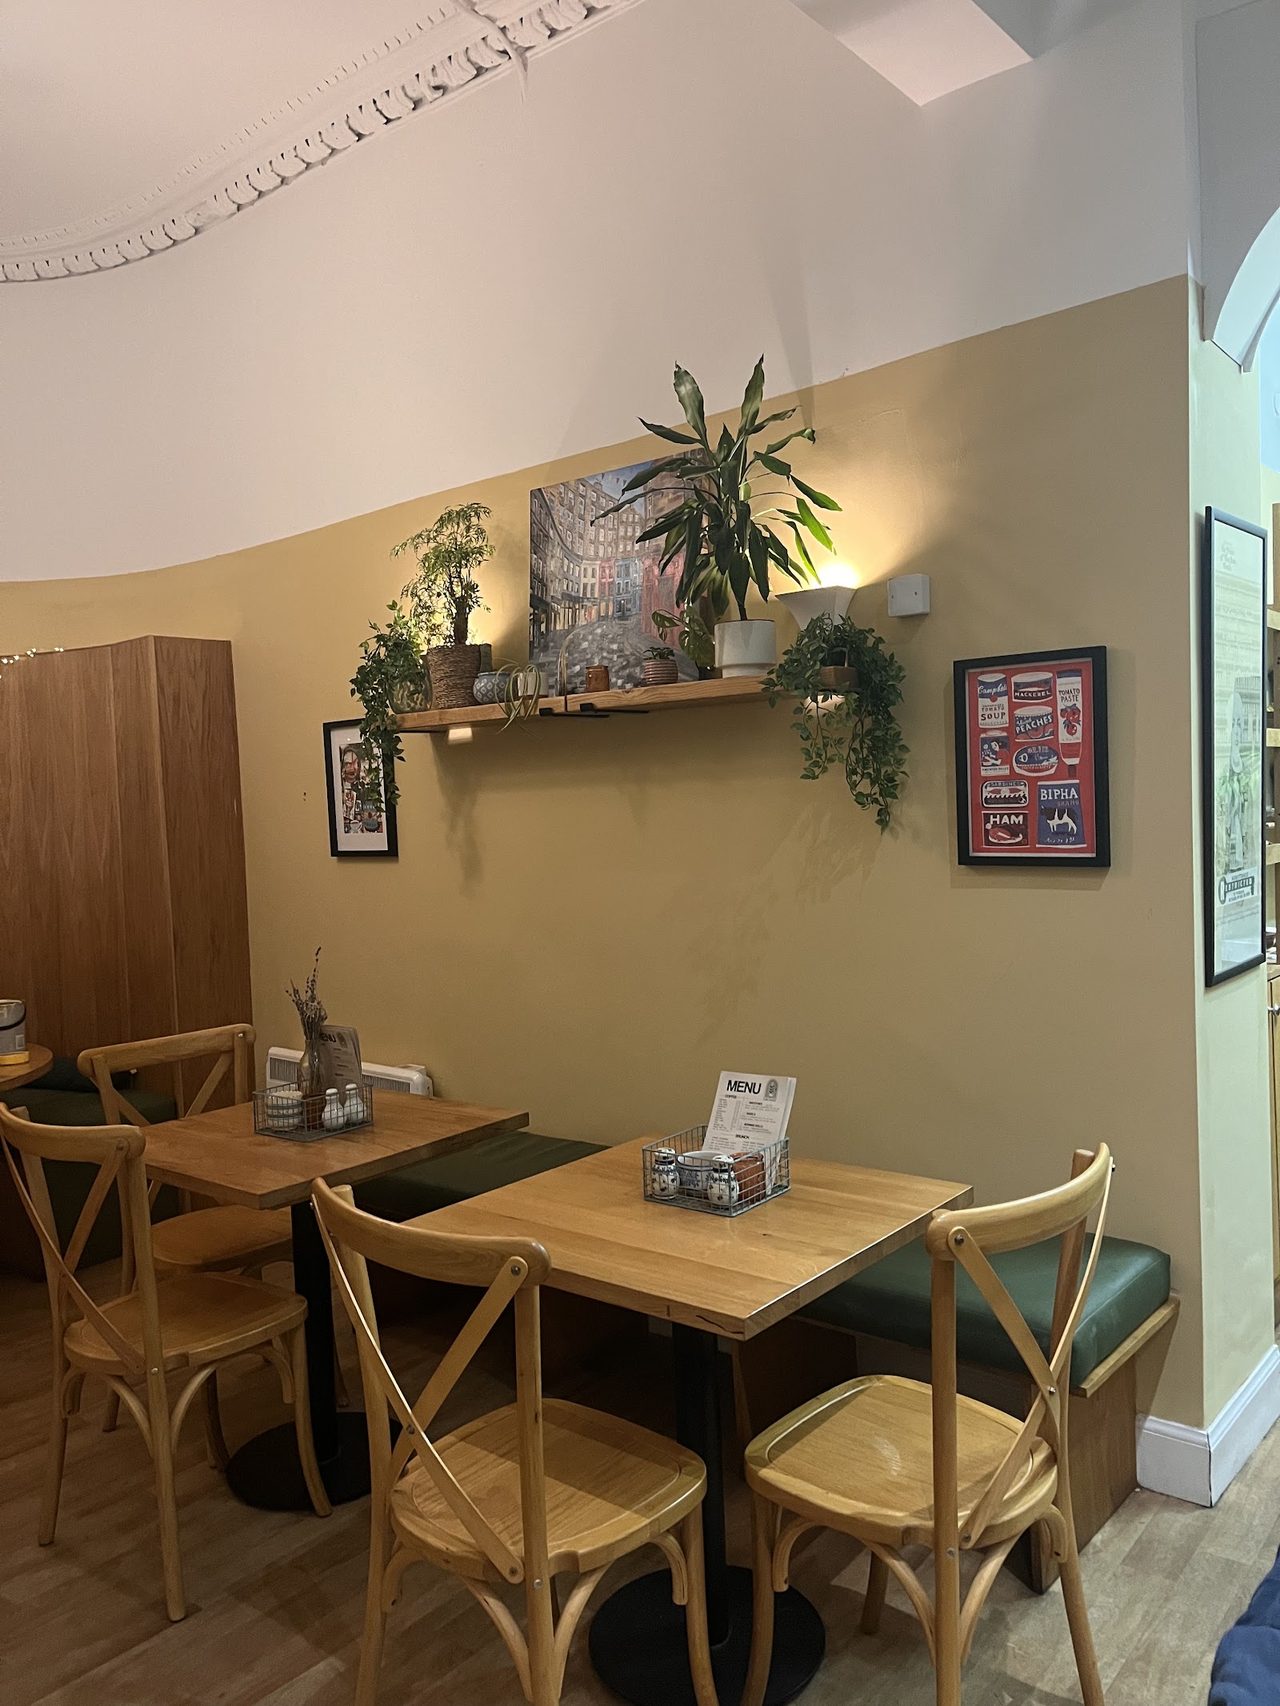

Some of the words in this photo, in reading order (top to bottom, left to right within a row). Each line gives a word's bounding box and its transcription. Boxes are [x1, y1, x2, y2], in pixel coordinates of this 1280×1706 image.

[981, 712, 1005, 721] SOUP
[1016, 715, 1052, 734] PEACHES
[1040, 787, 1079, 800] BIPHA
[990, 814, 1024, 825] HAM
[727, 1080, 761, 1094] MENU
